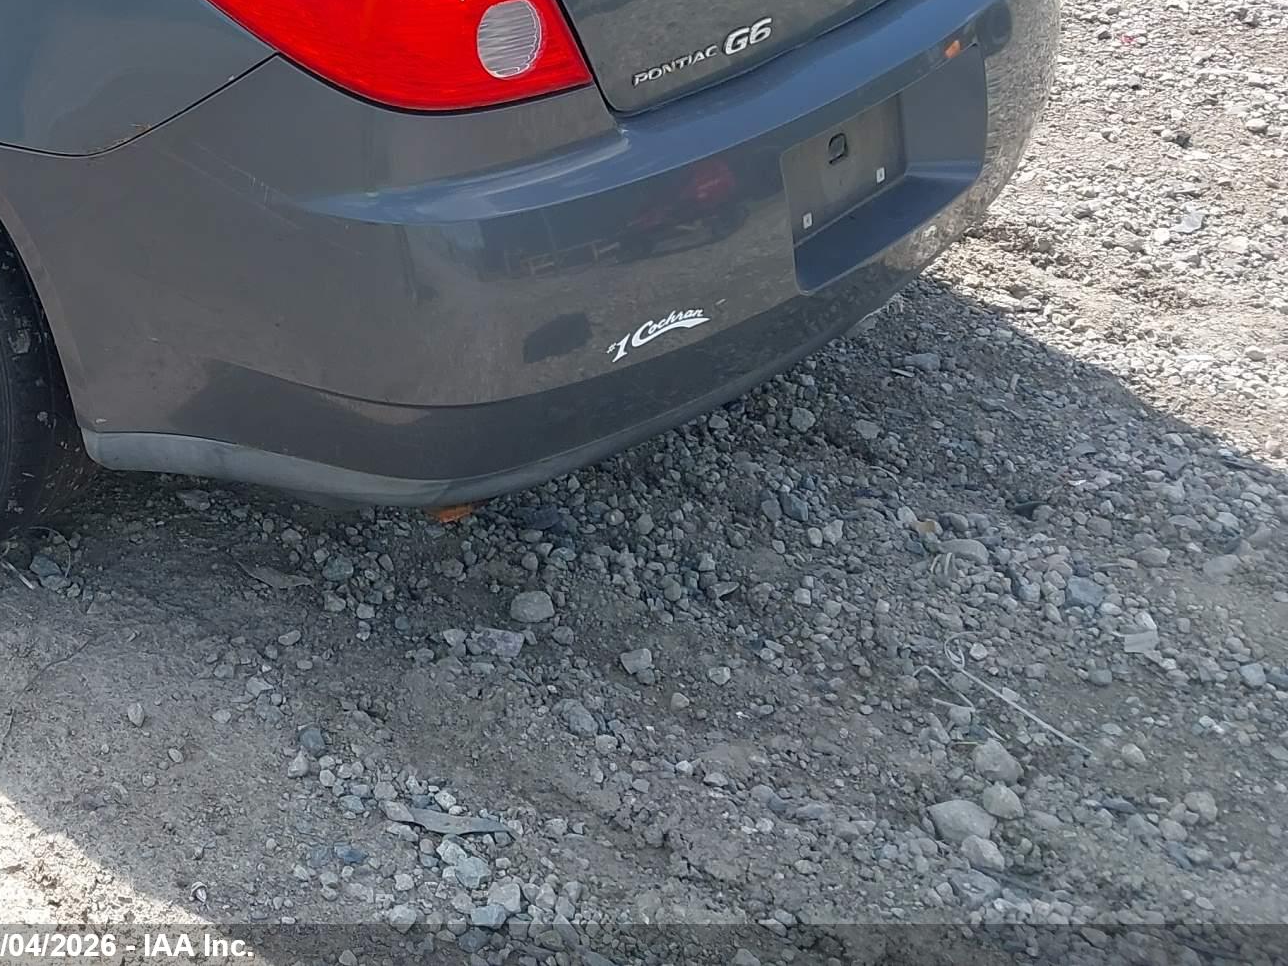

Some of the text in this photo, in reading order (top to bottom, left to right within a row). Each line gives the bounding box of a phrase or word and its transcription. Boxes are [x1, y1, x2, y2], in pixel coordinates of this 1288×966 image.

[634, 17, 772, 86] PONTIAC G6
[606, 309, 710, 363] #1 Cochran
